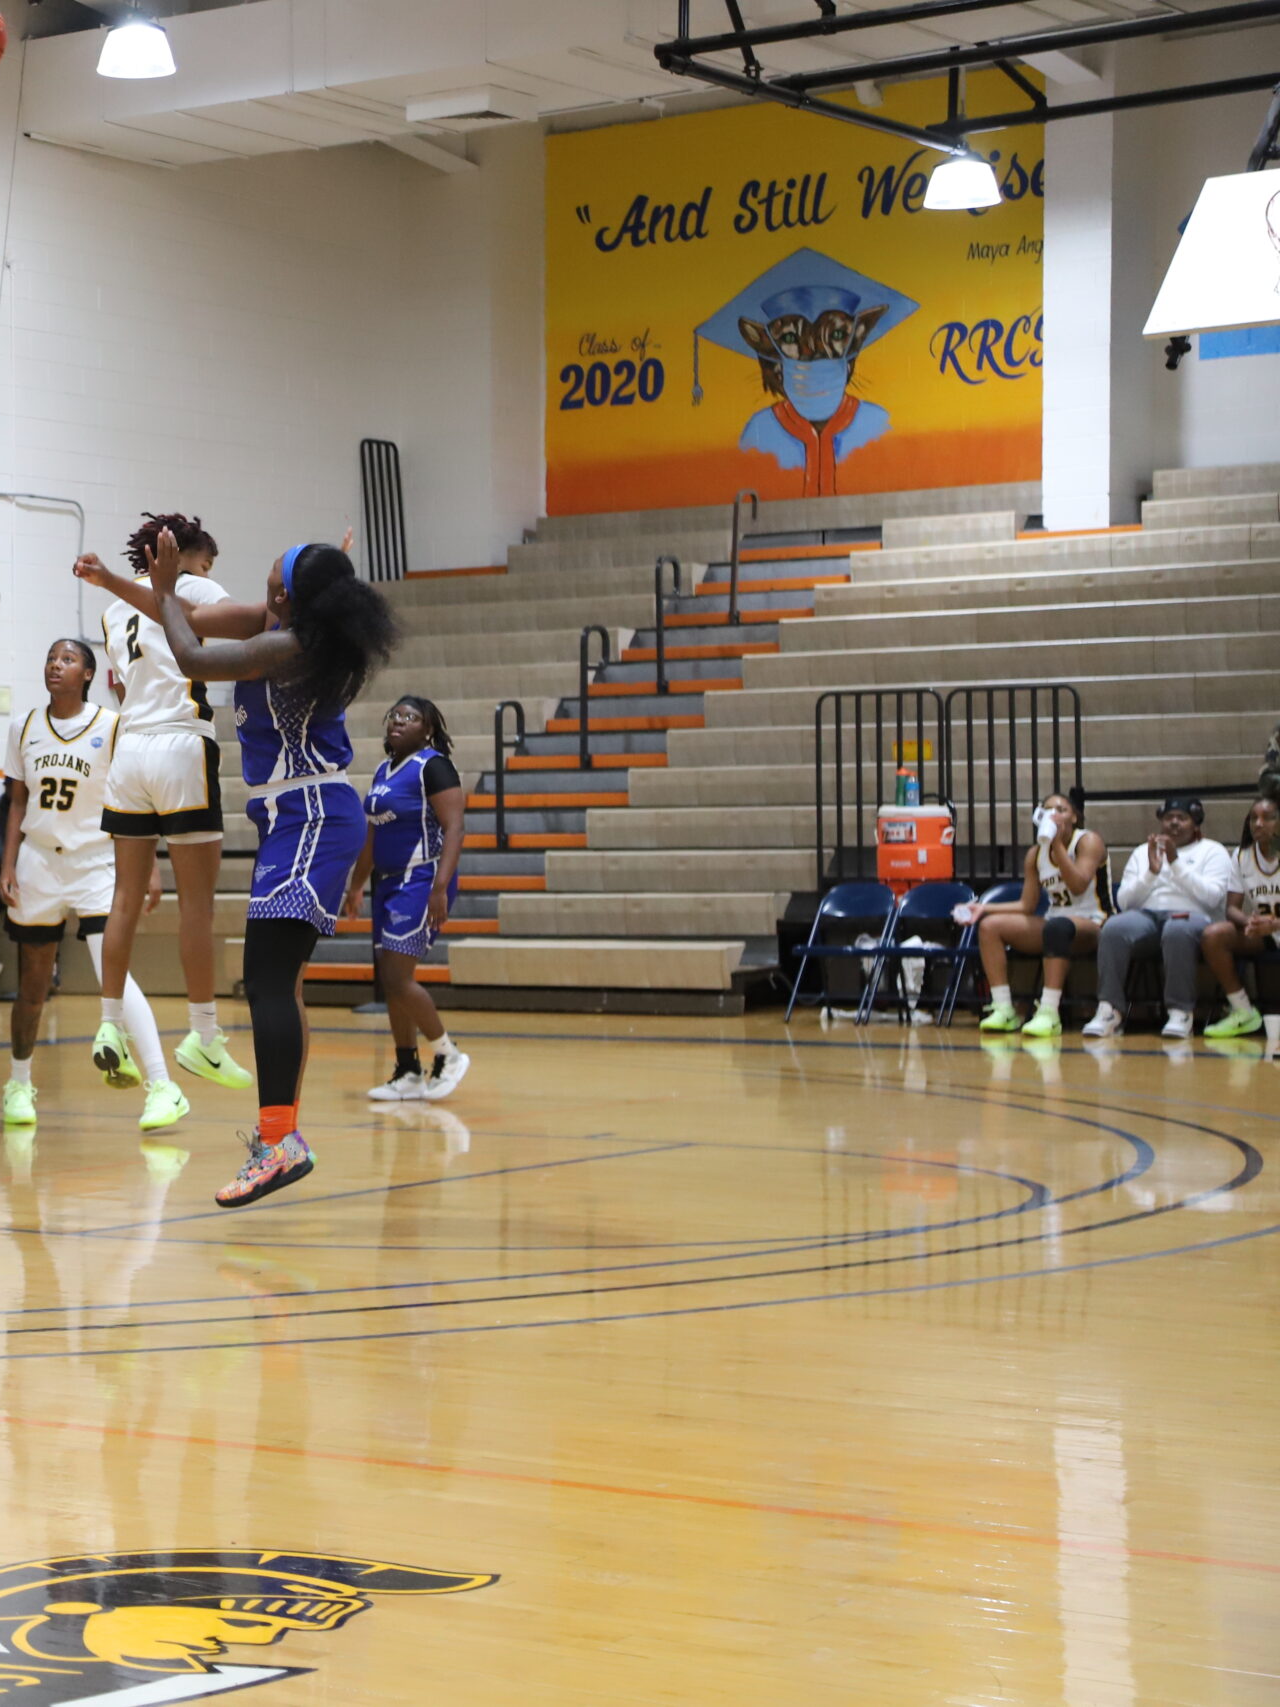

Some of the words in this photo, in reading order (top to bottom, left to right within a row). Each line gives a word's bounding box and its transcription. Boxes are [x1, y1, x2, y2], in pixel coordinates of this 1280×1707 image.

[733, 172, 837, 234] Still
[857, 149, 929, 219] We
[966, 242, 1010, 265] Maya
[578, 332, 619, 357] Class
[559, 357, 665, 411] 2020
[125, 613, 144, 665] 2
[34, 753, 91, 778] TROJANS
[39, 776, 78, 812] 25
